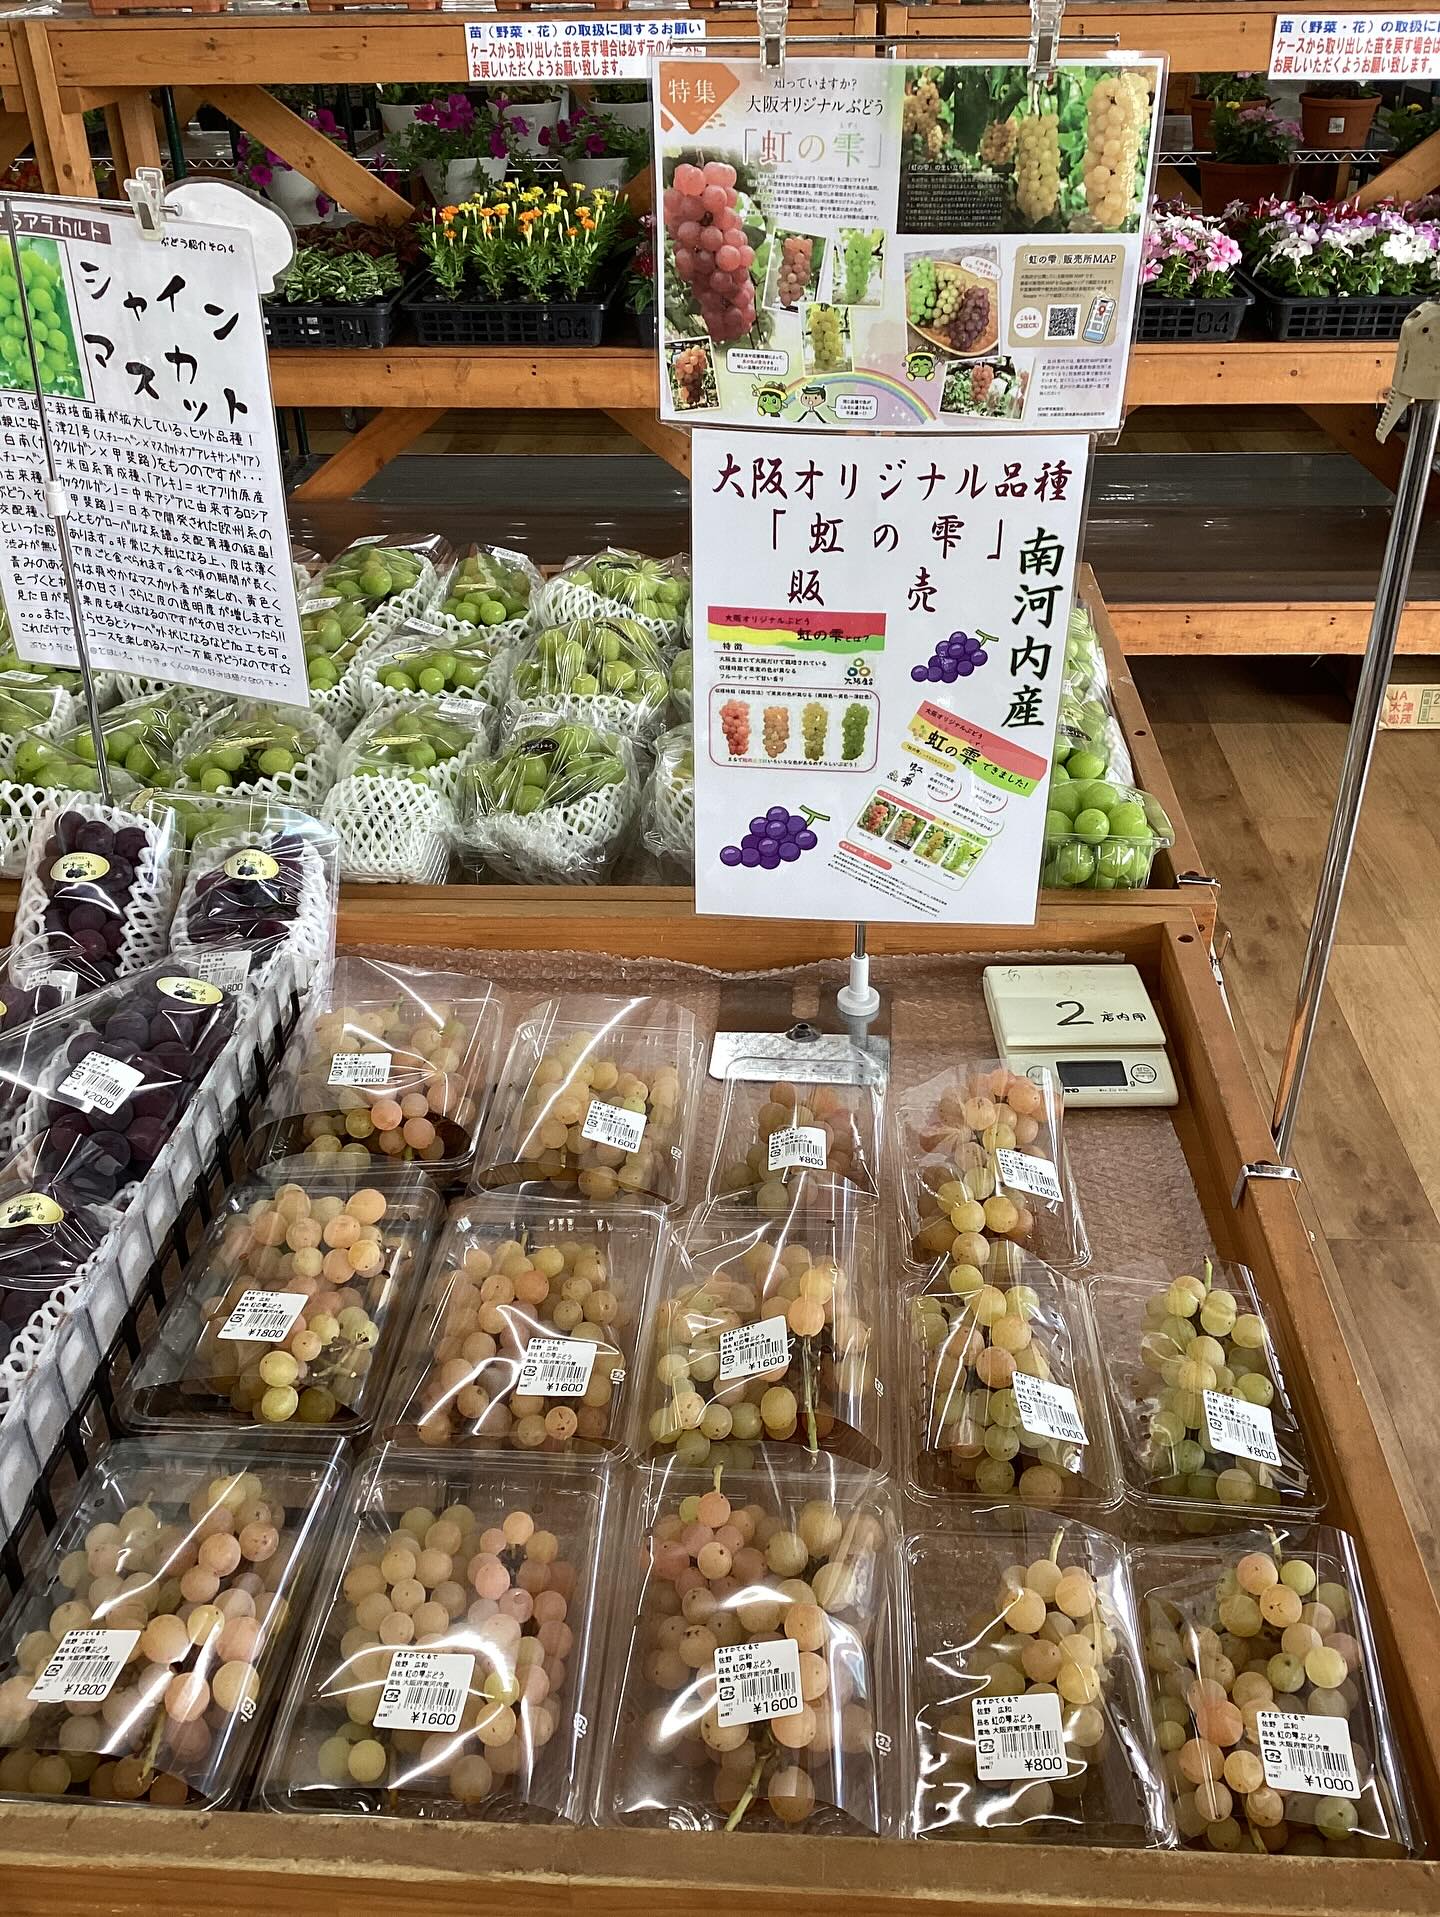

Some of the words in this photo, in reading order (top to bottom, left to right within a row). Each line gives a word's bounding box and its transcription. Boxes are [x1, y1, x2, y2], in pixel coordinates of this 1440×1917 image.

[469, 22, 702, 39] 苗（野菜・花）の取扱に関するお願い
[1280, 20, 1440, 33] 苗（野菜・花）の取扱に
[471, 40, 702, 59] ケースから取り出した苗を戻す場合は必ず元のケ
[473, 60, 624, 77] お戻しいただくようお願い致します。
[1274, 56, 1432, 73] お戻しいただくようお願い致します。
[668, 79, 717, 104] 特集
[746, 95, 884, 116] 大阪オリジナルぶどう
[742, 128, 883, 168] 「虹の雫」
[80, 261, 239, 340] シャイン
[1196, 312, 1230, 334] 04
[83, 334, 248, 424] マスカット
[712, 453, 1074, 502] 大阪オリジナル品種
[772, 509, 1004, 561] 「虹の雫」
[787, 566, 937, 614] 販売
[725, 613, 811, 627] 大阪オリジナルぶどう
[1000, 526, 1065, 729] 南河内産
[723, 642, 743, 651] 特徴
[1391, 691, 1408, 701] JA
[925, 731, 981, 765] 虹の雫
[983, 762, 1029, 790] できました!
[1056, 1000, 1094, 1026] 2
[84, 1089, 115, 1109] ¥2000
[607, 1136, 636, 1149] ¥1600
[799, 1155, 824, 1166] ¥800
[1028, 1184, 1060, 1198] ¥1000
[248, 1328, 284, 1338] ¥1800
[749, 1355, 785, 1370] ¥1600
[546, 1382, 583, 1392] ¥1600
[1048, 1424, 1084, 1440] ¥1000
[1246, 1445, 1276, 1460] ¥800
[733, 1659, 772, 1672] 虹の雫ぶどう
[63, 1684, 107, 1696] ¥1800
[753, 1696, 798, 1714] ¥1600
[411, 1712, 456, 1725] ¥1600
[992, 1714, 1033, 1725] 虹の雫ぶどう
[1277, 1730, 1321, 1742] 虹の雫ぶどう
[1024, 1757, 1062, 1772] ¥800
[1304, 1774, 1354, 1792] ¥1000
